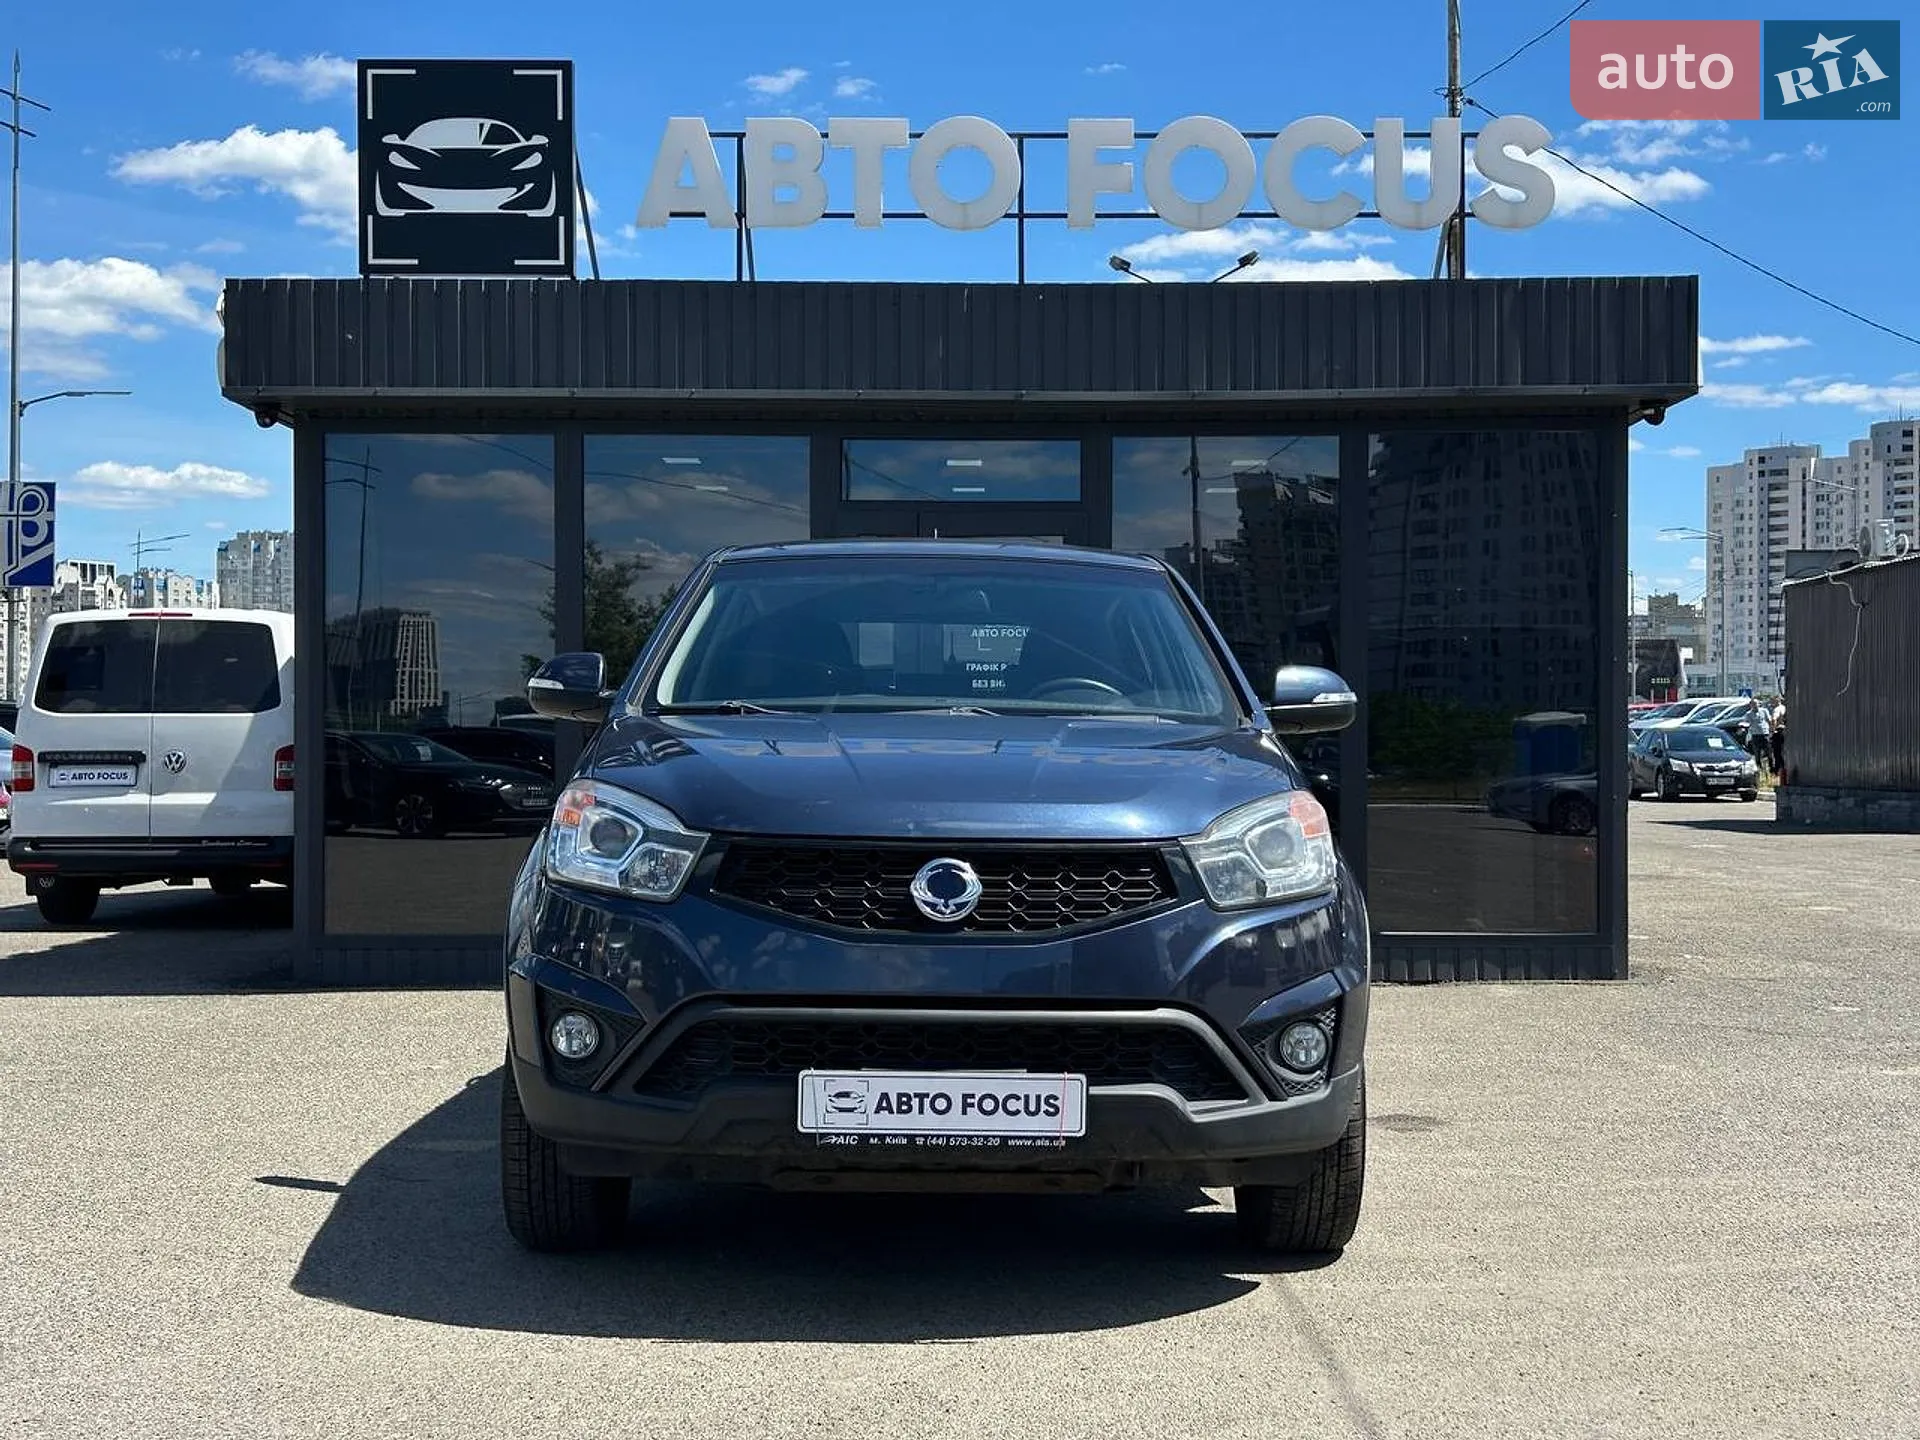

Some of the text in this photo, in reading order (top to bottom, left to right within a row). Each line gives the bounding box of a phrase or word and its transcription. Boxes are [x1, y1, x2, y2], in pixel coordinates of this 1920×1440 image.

[636, 115, 1555, 231] АВТО FOCUS
[70, 772, 128, 781] АВТО FOCUS
[873, 1092, 1060, 1117] АВТО FOCUS
[926, 1135, 947, 1147] (44)
[949, 1136, 1001, 1147] 573-32-20
